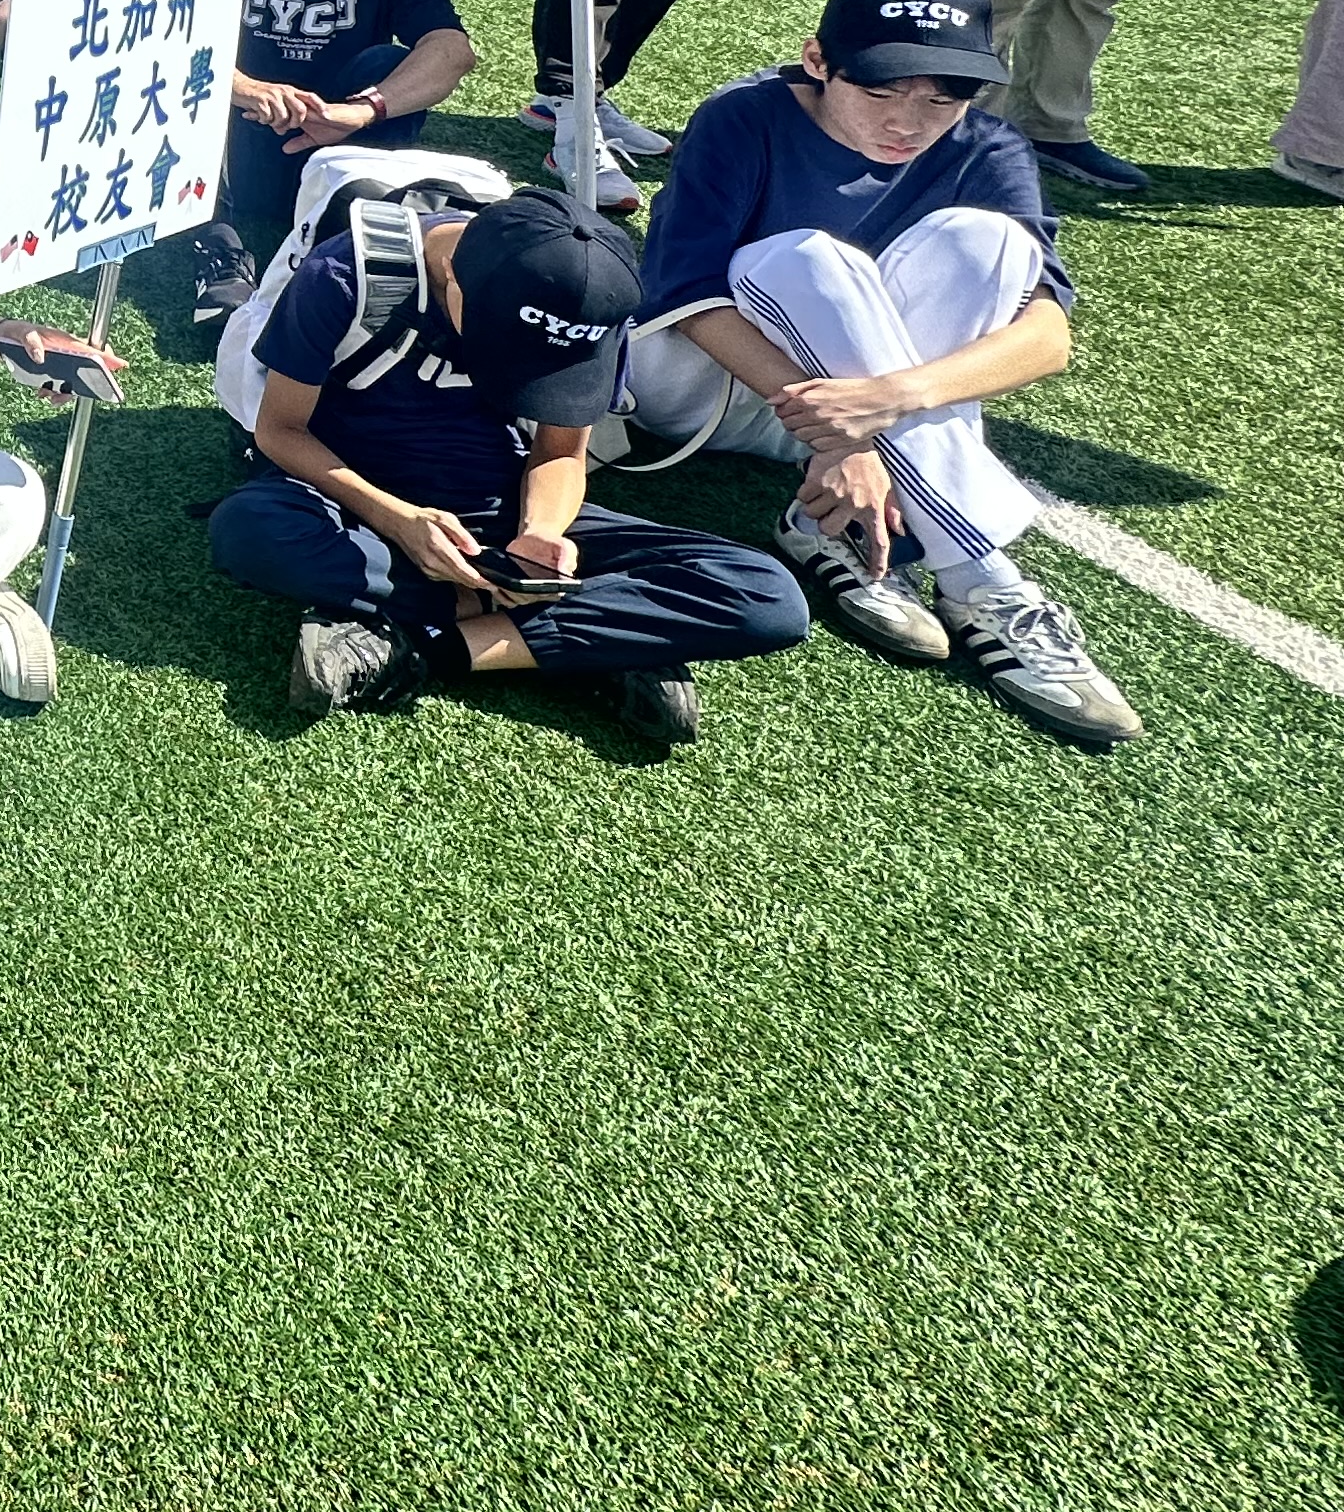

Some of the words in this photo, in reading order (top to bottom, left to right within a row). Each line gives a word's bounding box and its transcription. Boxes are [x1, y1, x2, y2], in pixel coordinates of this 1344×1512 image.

[879, 1, 970, 27] CYCU
[34, 45, 215, 163] 中原大學
[44, 133, 181, 243] 校友會
[519, 305, 609, 342] CYCU
